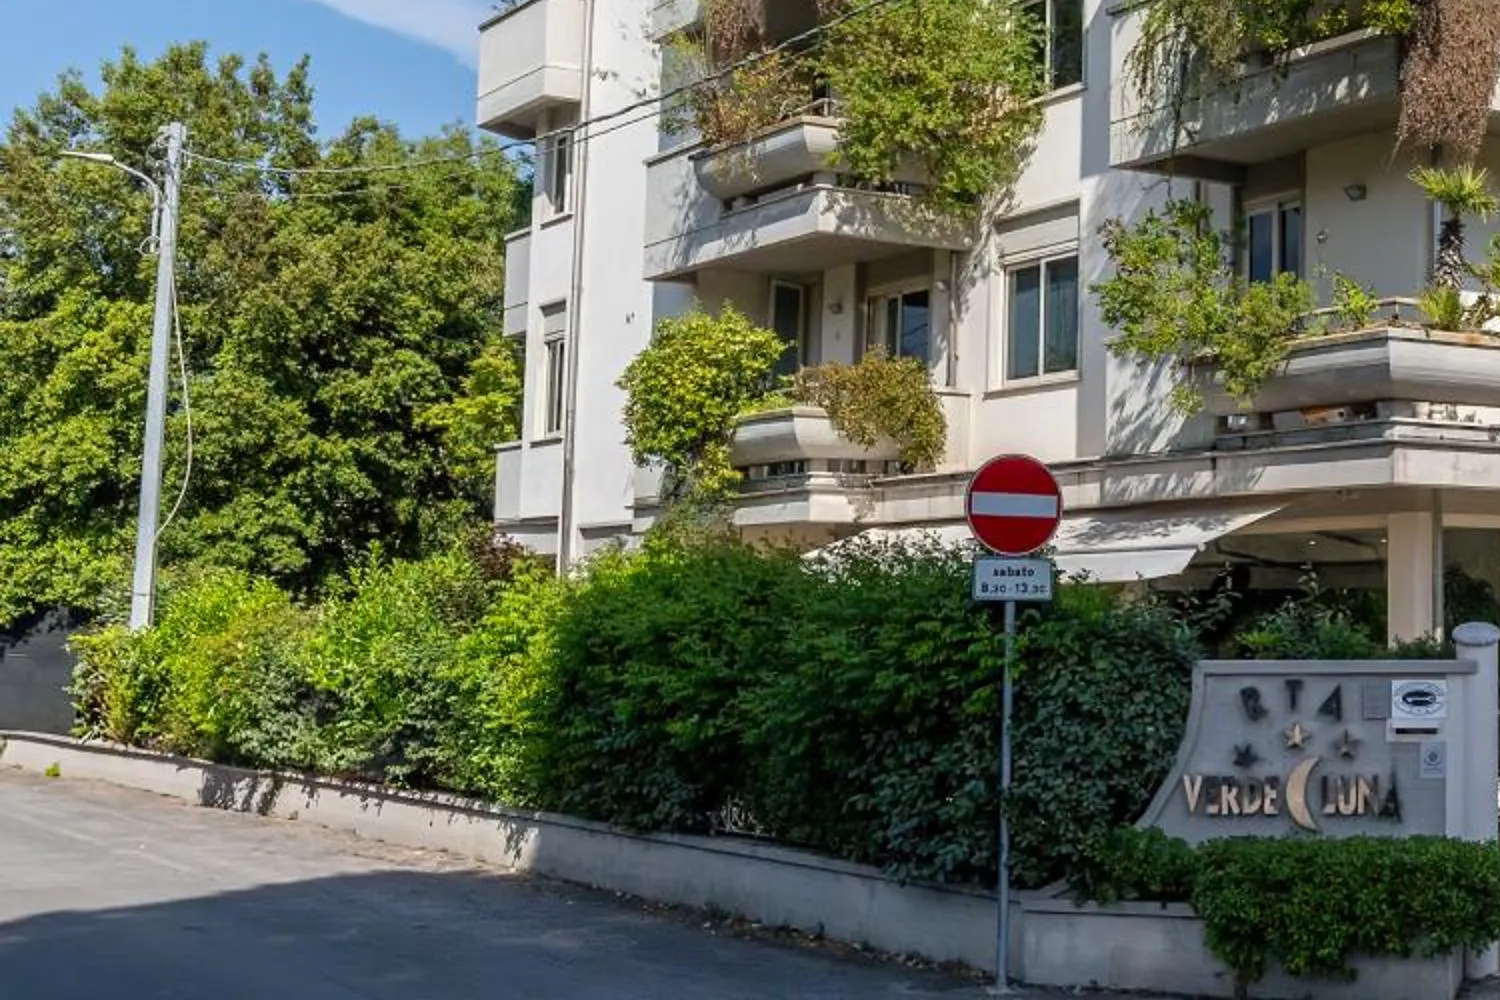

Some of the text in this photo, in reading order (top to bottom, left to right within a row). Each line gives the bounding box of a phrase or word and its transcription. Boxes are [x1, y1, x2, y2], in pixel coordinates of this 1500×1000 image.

[993, 566, 1035, 577] sabato
[1183, 768, 1403, 822] VERDE LUNA
